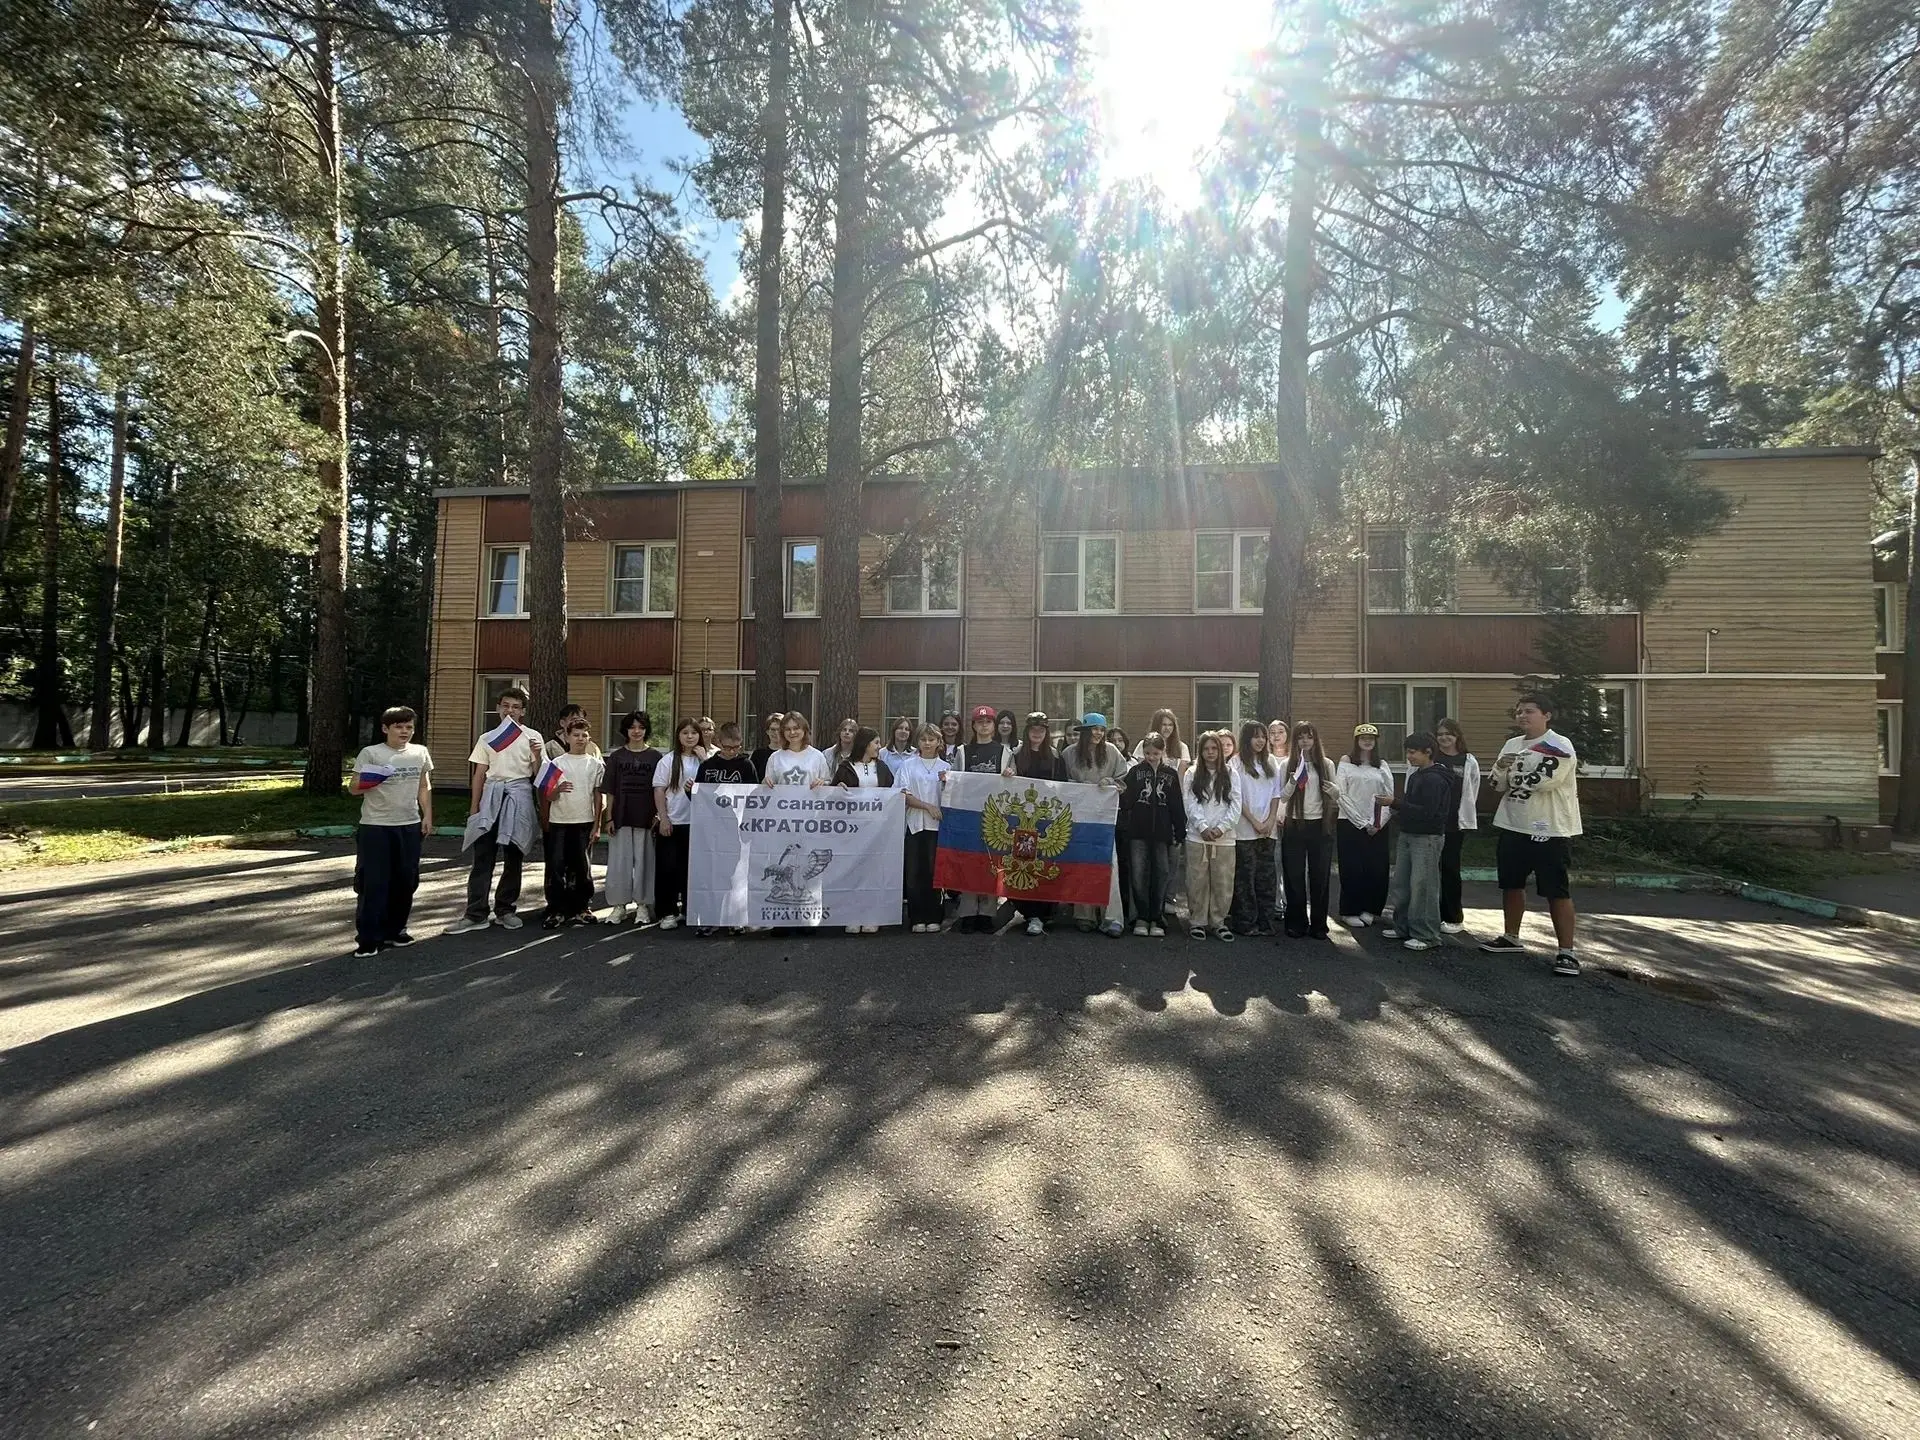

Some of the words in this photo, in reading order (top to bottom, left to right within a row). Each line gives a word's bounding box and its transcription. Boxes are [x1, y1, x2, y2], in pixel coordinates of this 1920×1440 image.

[704, 769, 743, 783] FILA
[715, 795, 771, 809] ФГБУ
[777, 798, 883, 815] санаторий
[738, 818, 859, 834] «КРАТОВО»
